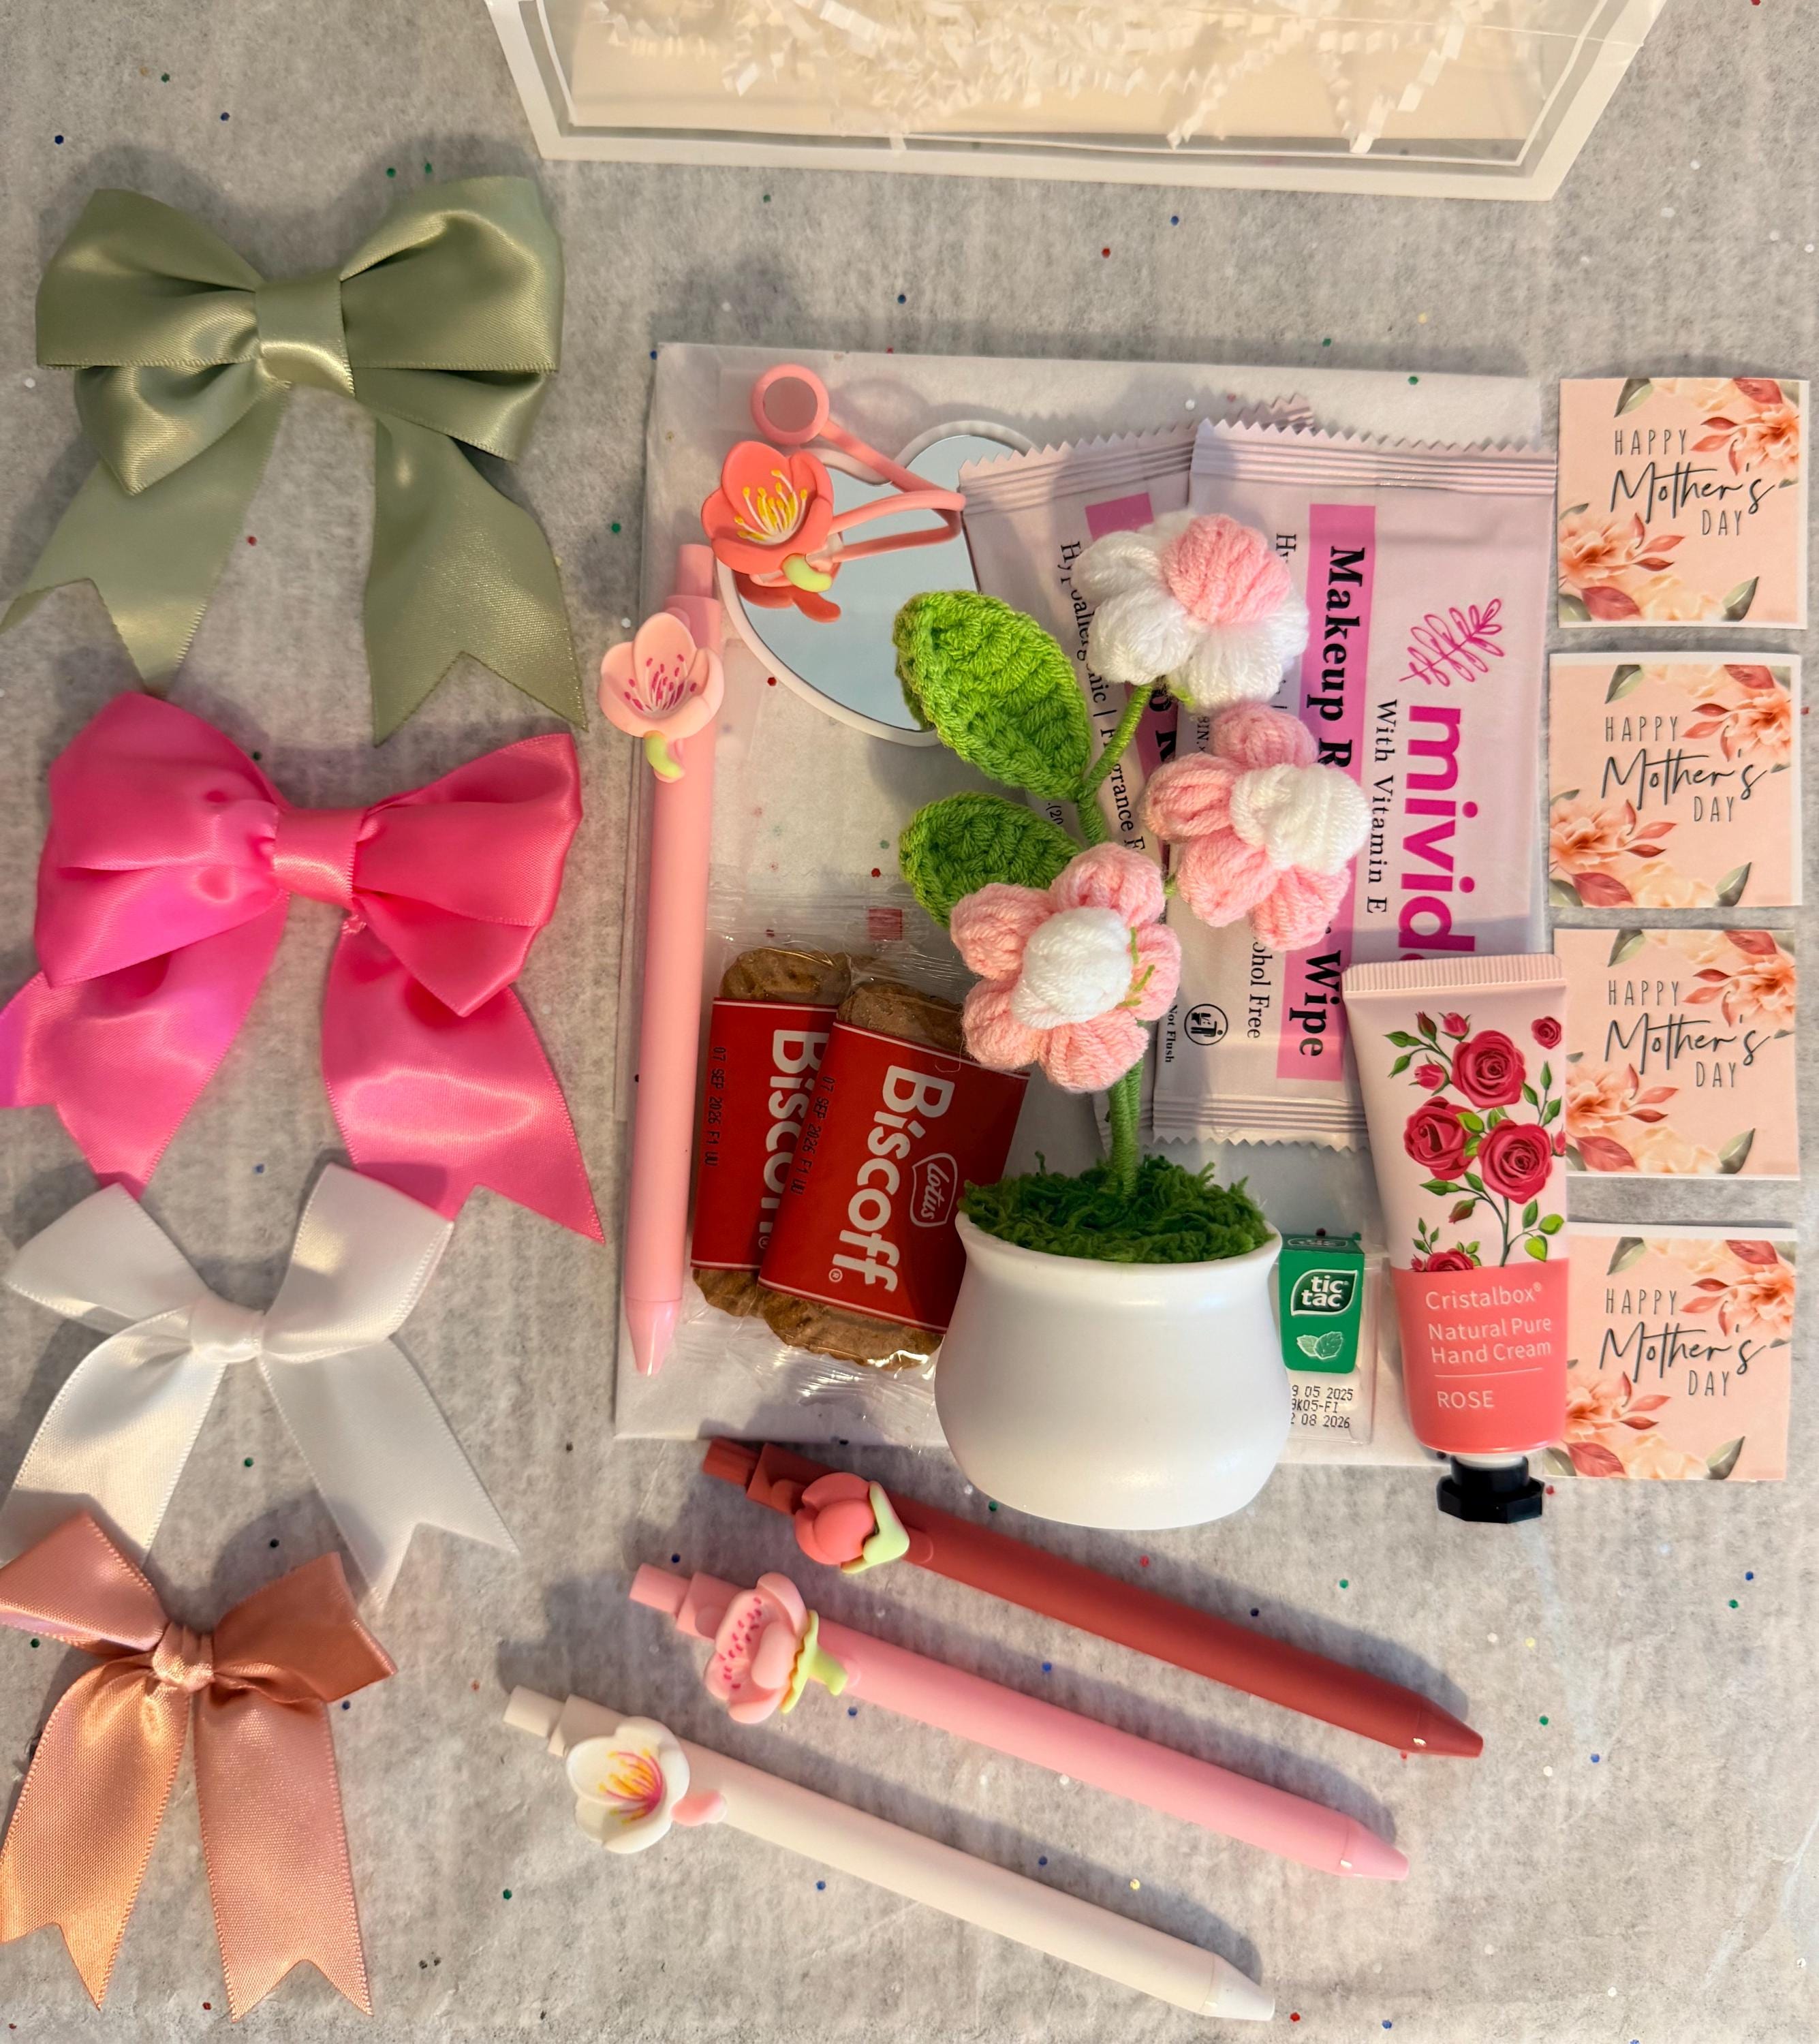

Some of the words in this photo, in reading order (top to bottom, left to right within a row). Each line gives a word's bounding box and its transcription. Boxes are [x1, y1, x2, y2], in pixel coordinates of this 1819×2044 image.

[1615, 429, 1686, 455] HAPPY
[1610, 461, 1775, 524] Mother's
[1702, 510, 1742, 536] DAY
[1306, 546, 1365, 722] Makeup
[1374, 698, 1397, 762] With
[1605, 716, 1677, 741] HAPPY
[1601, 748, 1767, 811] Mother's
[1694, 796, 1734, 822] DAY
[1368, 775, 1394, 884] Vitamin
[1398, 705, 1478, 960] mivid
[1367, 897, 1387, 913] E
[1289, 950, 1341, 1056] Wipe
[1608, 980, 1679, 1006] HAPPY
[1247, 994, 1270, 1038] Free
[713, 1047, 726, 1062] 07
[1165, 1031, 1176, 1062] Flush
[1604, 1012, 1770, 1074] Mother's
[711, 1068, 725, 1090] SEP
[820, 1076, 835, 1092] 07
[1696, 1062, 1736, 1087] DAY
[708, 1096, 723, 1124] 2026
[813, 1096, 830, 1119] SEP
[706, 1130, 720, 1145] F1
[802, 1123, 822, 1154] 2026
[796, 1158, 813, 1174] F1
[1301, 1286, 1342, 1307] tac
[1311, 1275, 1344, 1293] tic
[1606, 1288, 1677, 1315] HAPPY
[1428, 1318, 1507, 1341] Natural
[1512, 1318, 1551, 1335] Pure
[1431, 1344, 1488, 1363] Hand
[1493, 1341, 1551, 1361] Cream
[1599, 1321, 1766, 1383] Mother's
[1305, 1385, 1320, 1397] 05
[1326, 1387, 1354, 1401] 2025
[1688, 1369, 1729, 1395] DAY
[1437, 1390, 1494, 1409] ROSE
[1301, 1413, 1317, 1426] 08
[1322, 1415, 1350, 1428] 2026
